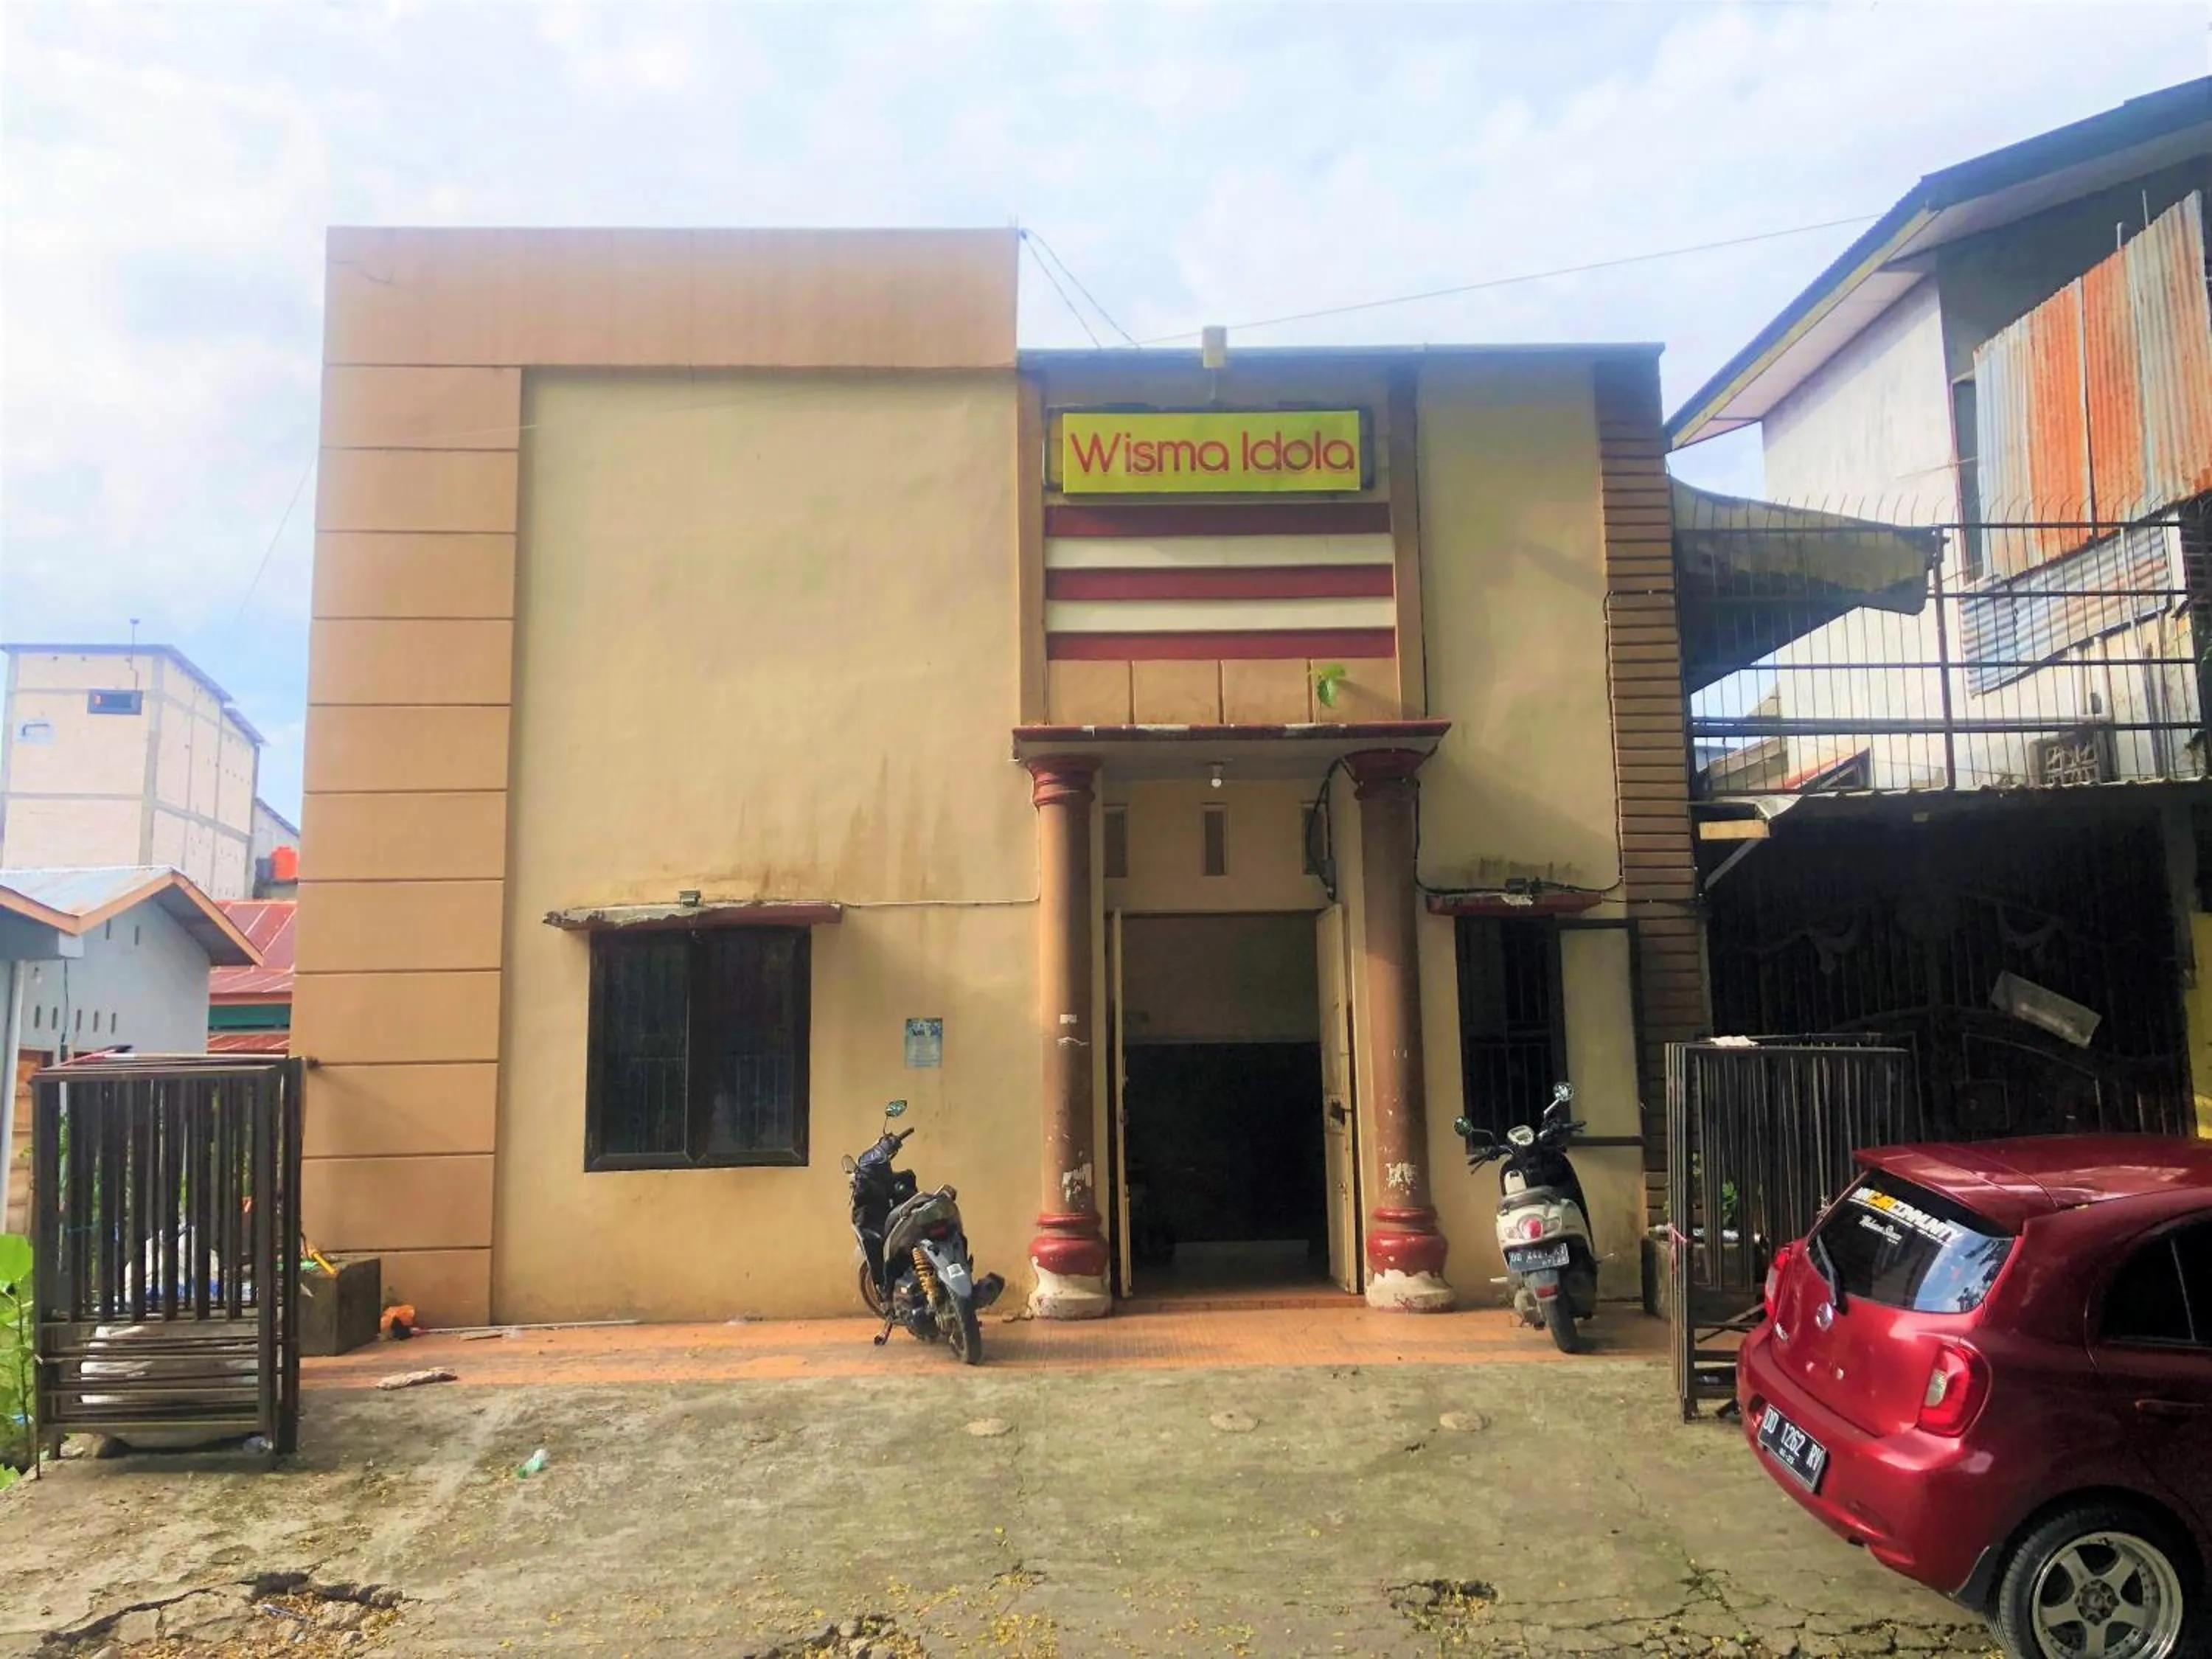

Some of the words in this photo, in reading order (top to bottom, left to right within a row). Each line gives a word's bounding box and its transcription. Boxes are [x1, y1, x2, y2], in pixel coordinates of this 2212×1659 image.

[1069, 431, 1230, 473] Wisma
[1242, 430, 1355, 472] Idola
[1762, 1407, 1779, 1434] DD
[1781, 1422, 1806, 1457] 1262
